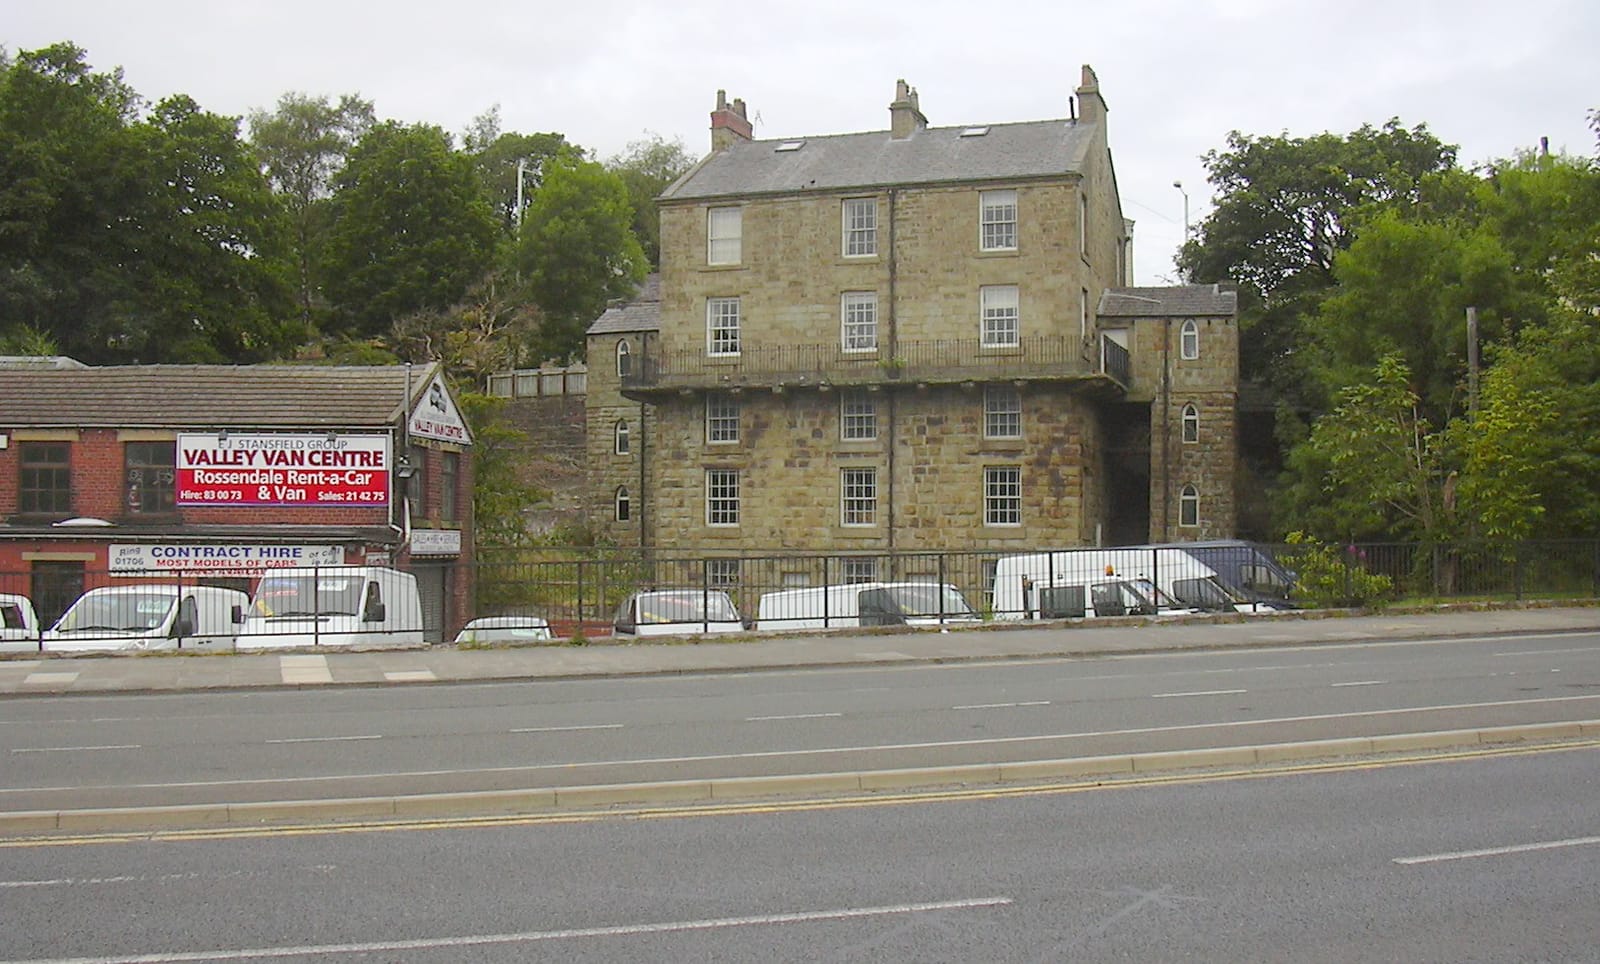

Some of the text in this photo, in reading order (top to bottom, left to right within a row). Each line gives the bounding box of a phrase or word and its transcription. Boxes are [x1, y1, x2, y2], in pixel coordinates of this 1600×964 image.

[239, 440, 304, 450] STANSFIELD
[307, 440, 348, 450] GROUP
[183, 449, 384, 467] VALLEY VAN CENTRE
[194, 469, 372, 486] Rossendale Rent-a-Car
[180, 490, 243, 500] Hire: 83 00 73
[257, 485, 306, 500] & Van
[317, 491, 385, 501] Sales: 21 42 75
[119, 547, 141, 557] Ring
[151, 547, 303, 558] CONTRACT HIRE
[115, 557, 145, 566] 01706
[156, 559, 297, 568] MOST MODELS OF CARS
